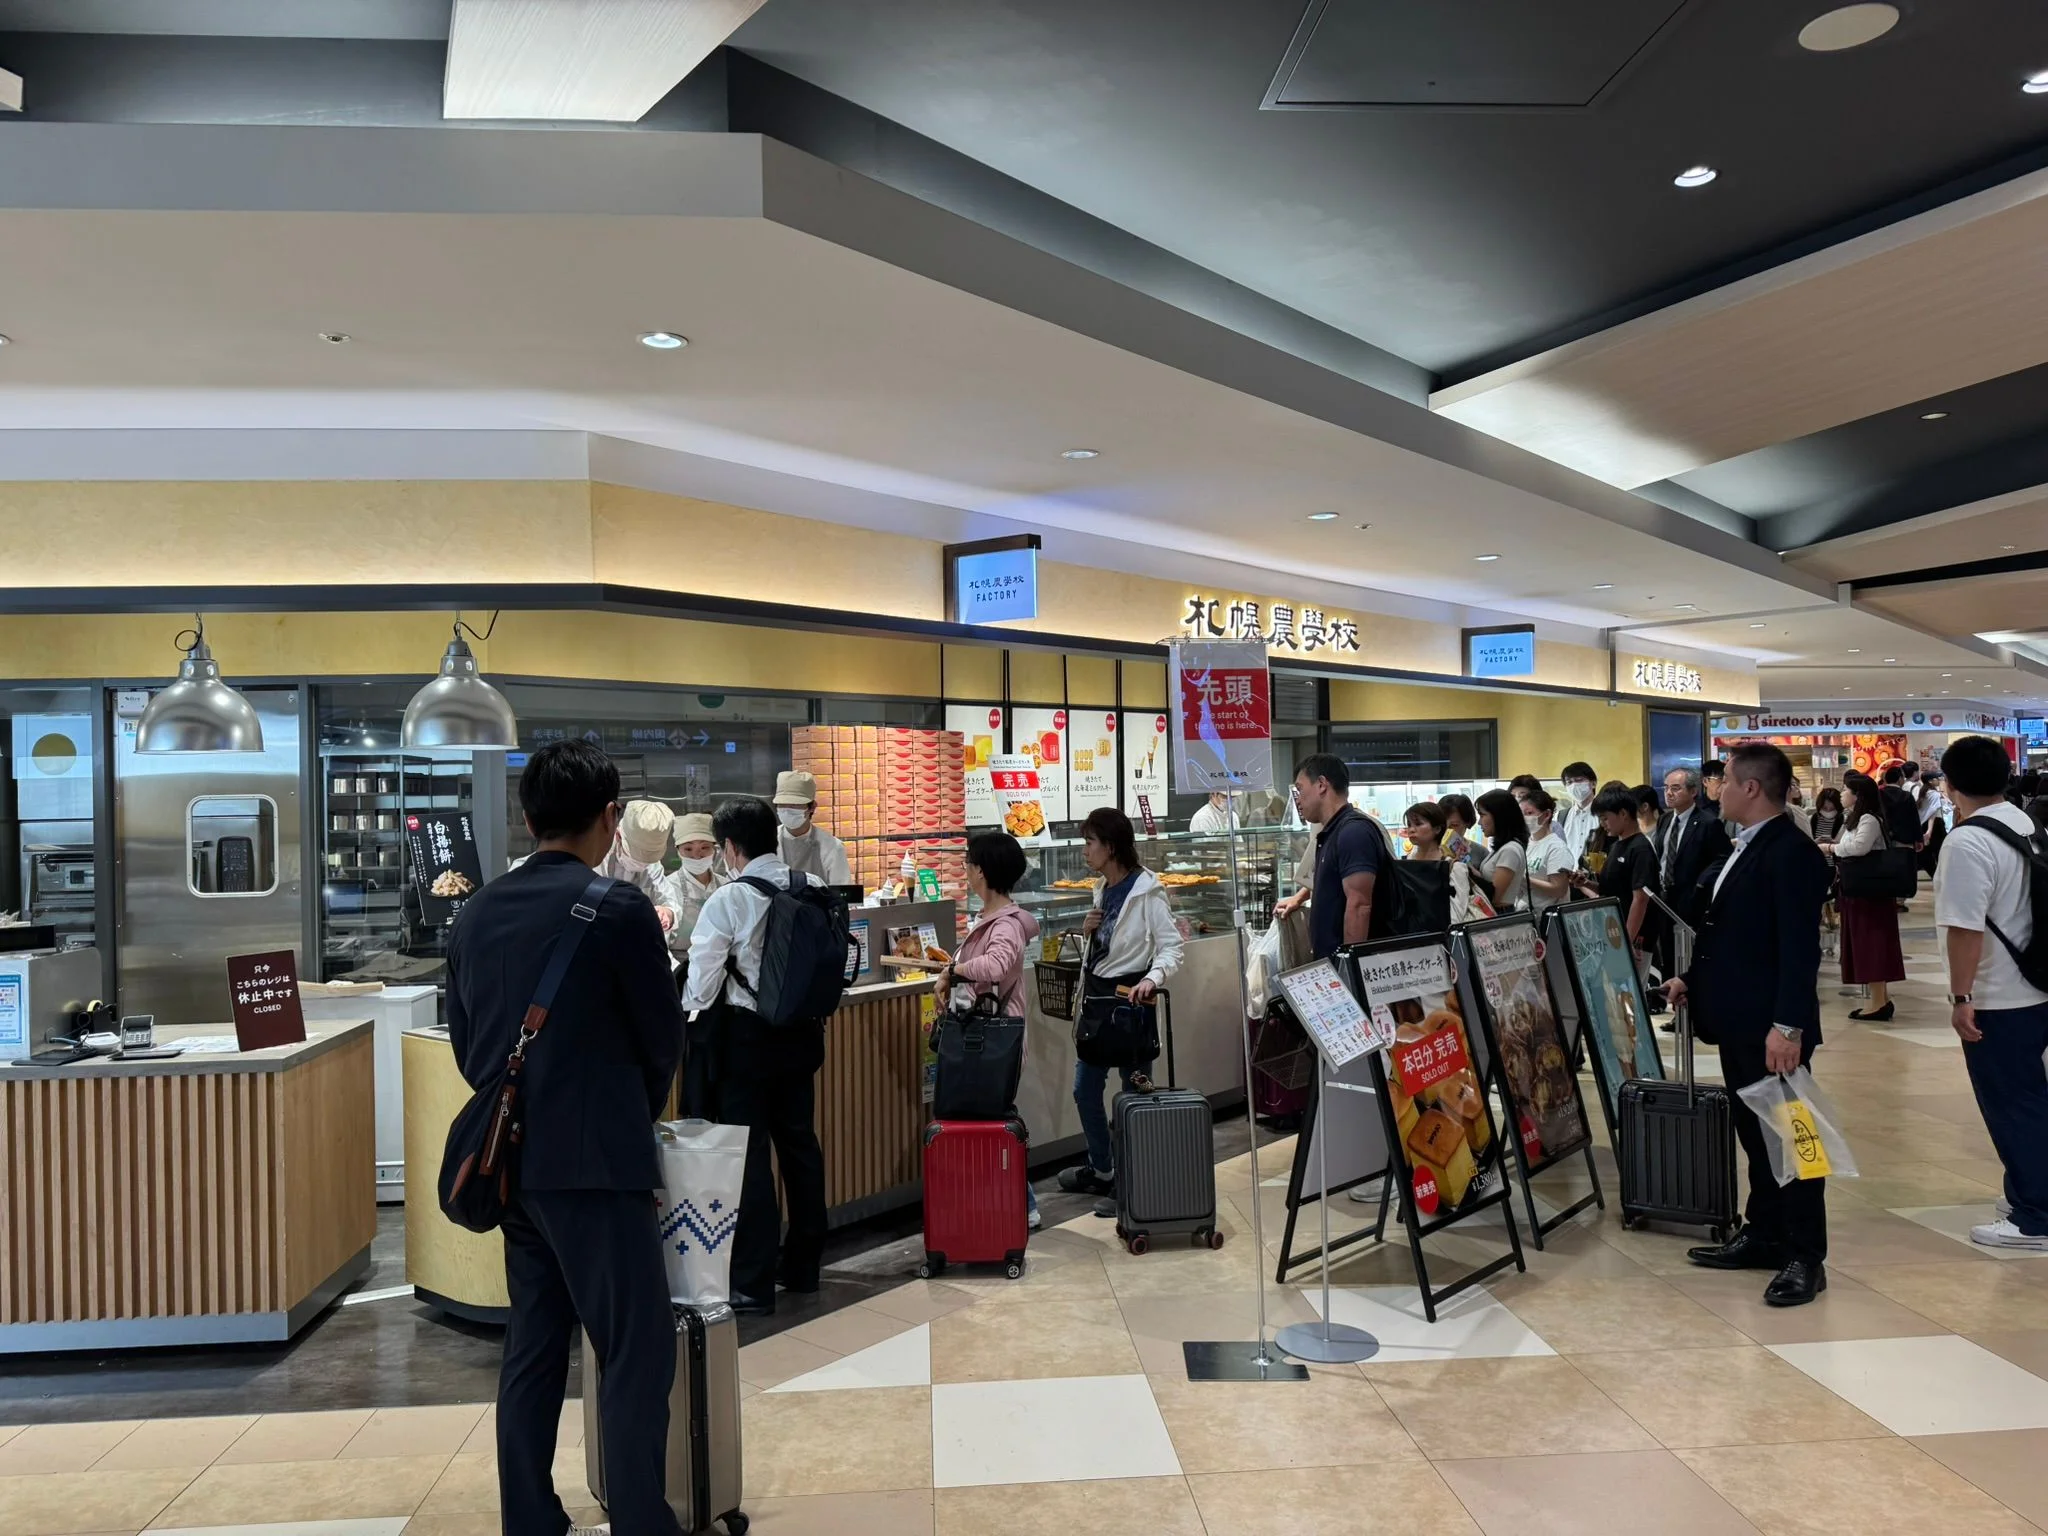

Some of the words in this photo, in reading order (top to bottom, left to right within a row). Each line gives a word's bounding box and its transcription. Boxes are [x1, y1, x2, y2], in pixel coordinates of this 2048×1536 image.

[976, 589, 1017, 602] FACTORY
[1184, 595, 1361, 651] 札幌農學校
[1484, 654, 1519, 663] FACTORY
[1197, 674, 1254, 707] 先頭
[1217, 710, 1237, 719] start
[1761, 715, 1814, 728] siretoco
[1817, 714, 1842, 729] sky
[1845, 714, 1891, 726] sweets
[1227, 722, 1235, 730] is
[1002, 772, 1030, 787] 完売
[236, 975, 291, 989] こちらのレジは
[237, 988, 293, 1005] 休止中です
[253, 1004, 282, 1014] CLOSED
[1402, 1044, 1433, 1075] 本日分
[1434, 1031, 1459, 1061] 完売
[1421, 1068, 1438, 1084] SOLD
[1437, 1061, 1450, 1076] OUT
